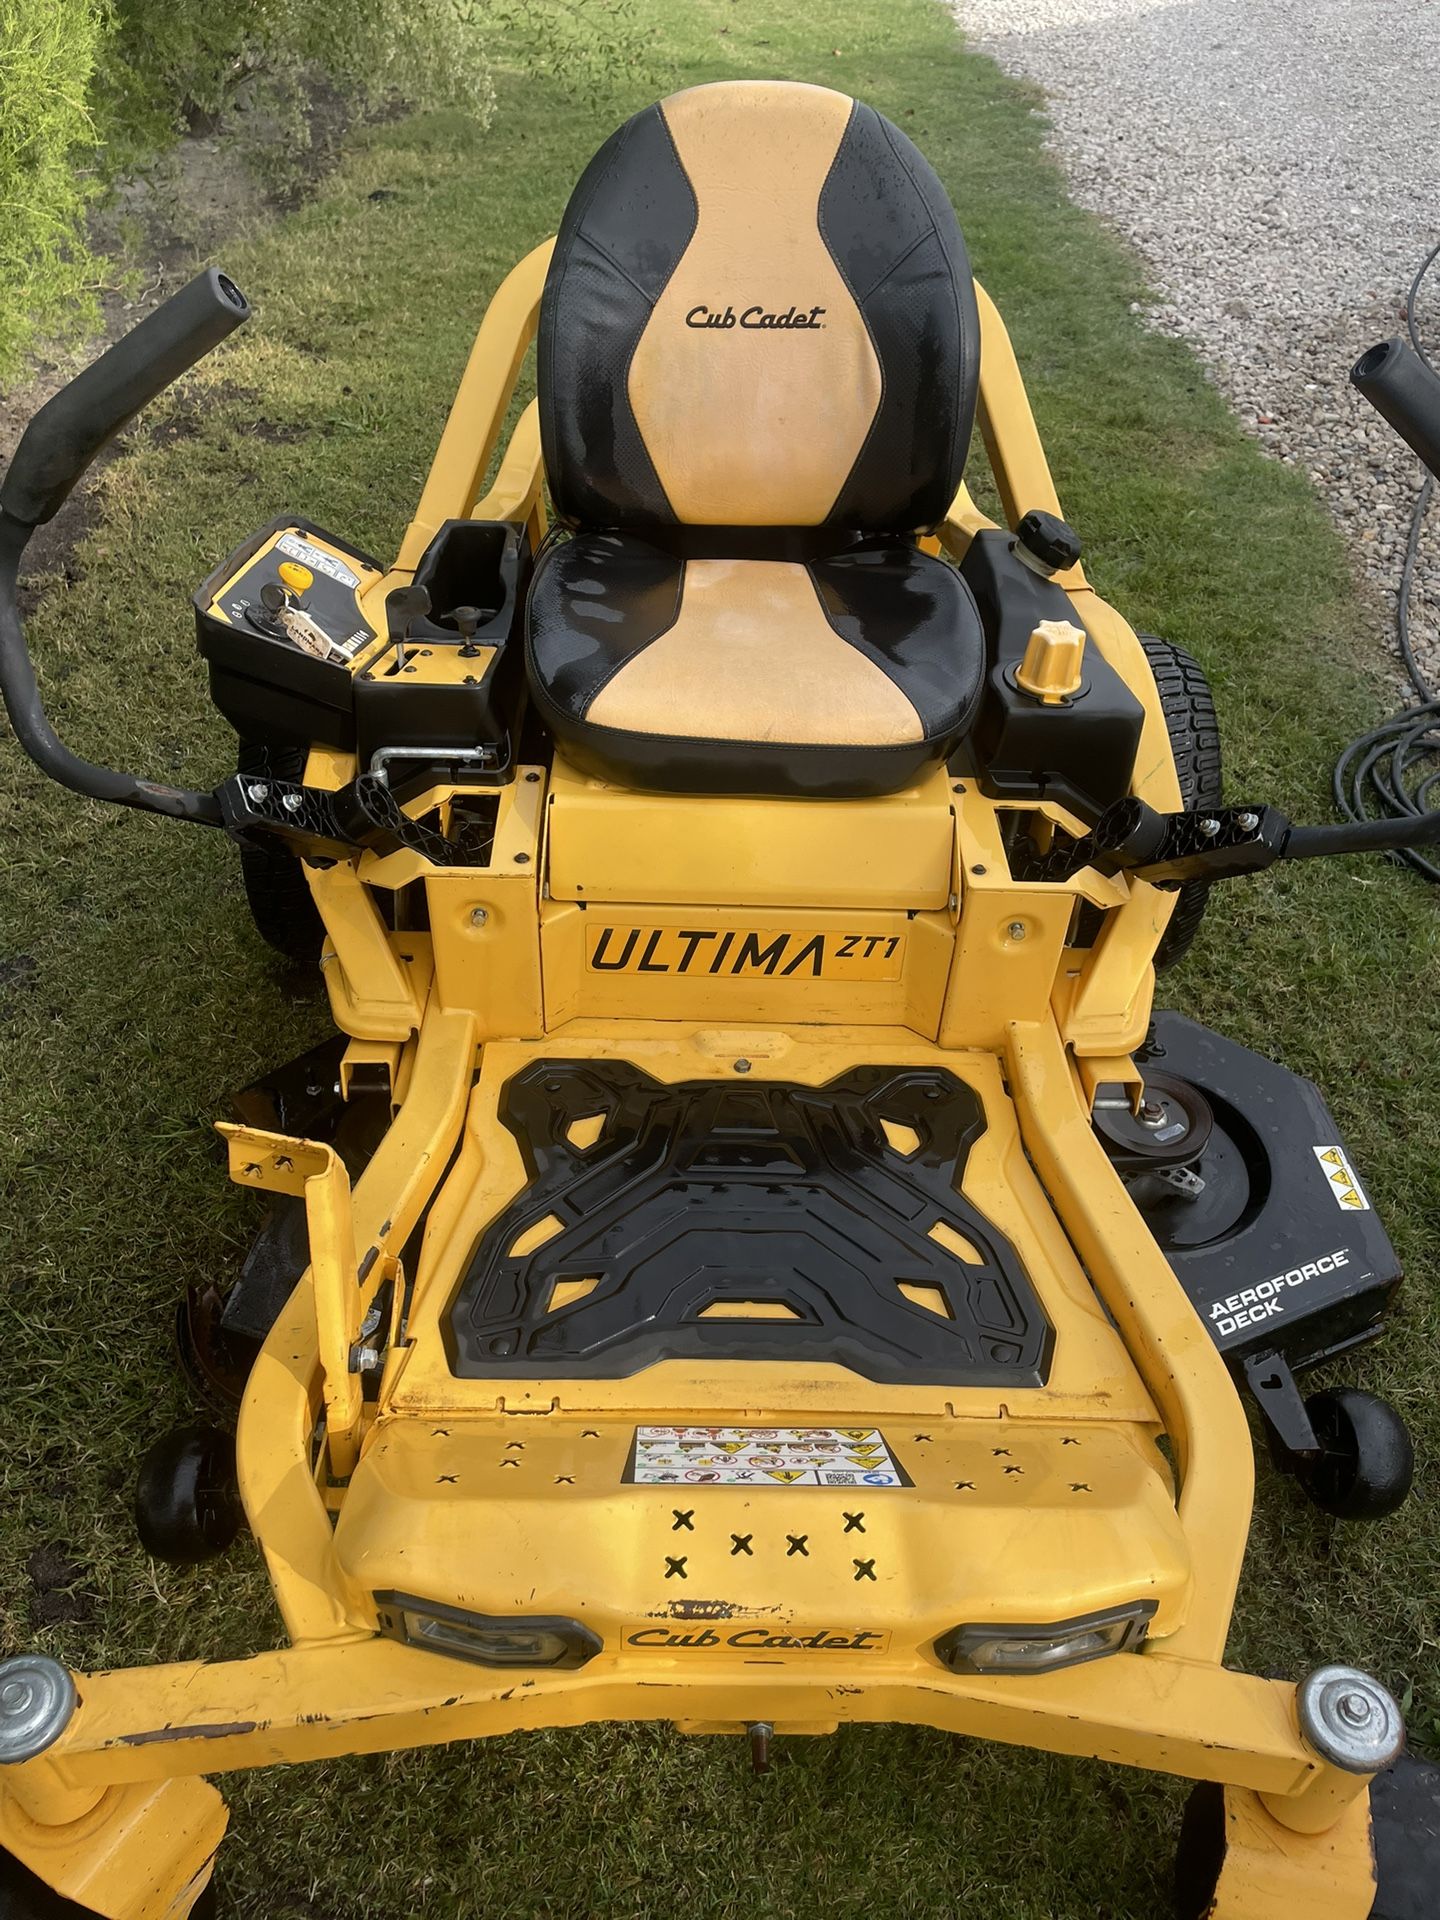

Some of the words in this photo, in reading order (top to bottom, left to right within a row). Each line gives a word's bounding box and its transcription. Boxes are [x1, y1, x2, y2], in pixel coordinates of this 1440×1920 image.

[685, 305, 736, 329] Cub
[740, 306, 826, 329] Cadet
[591, 928, 825, 976] ULTIMA
[835, 936, 900, 958] ZT1
[1209, 1249, 1350, 1320] AEROFORCE
[1215, 1297, 1284, 1337] DECK
[627, 1628, 721, 1648] Cub
[726, 1629, 884, 1650] Cadet
